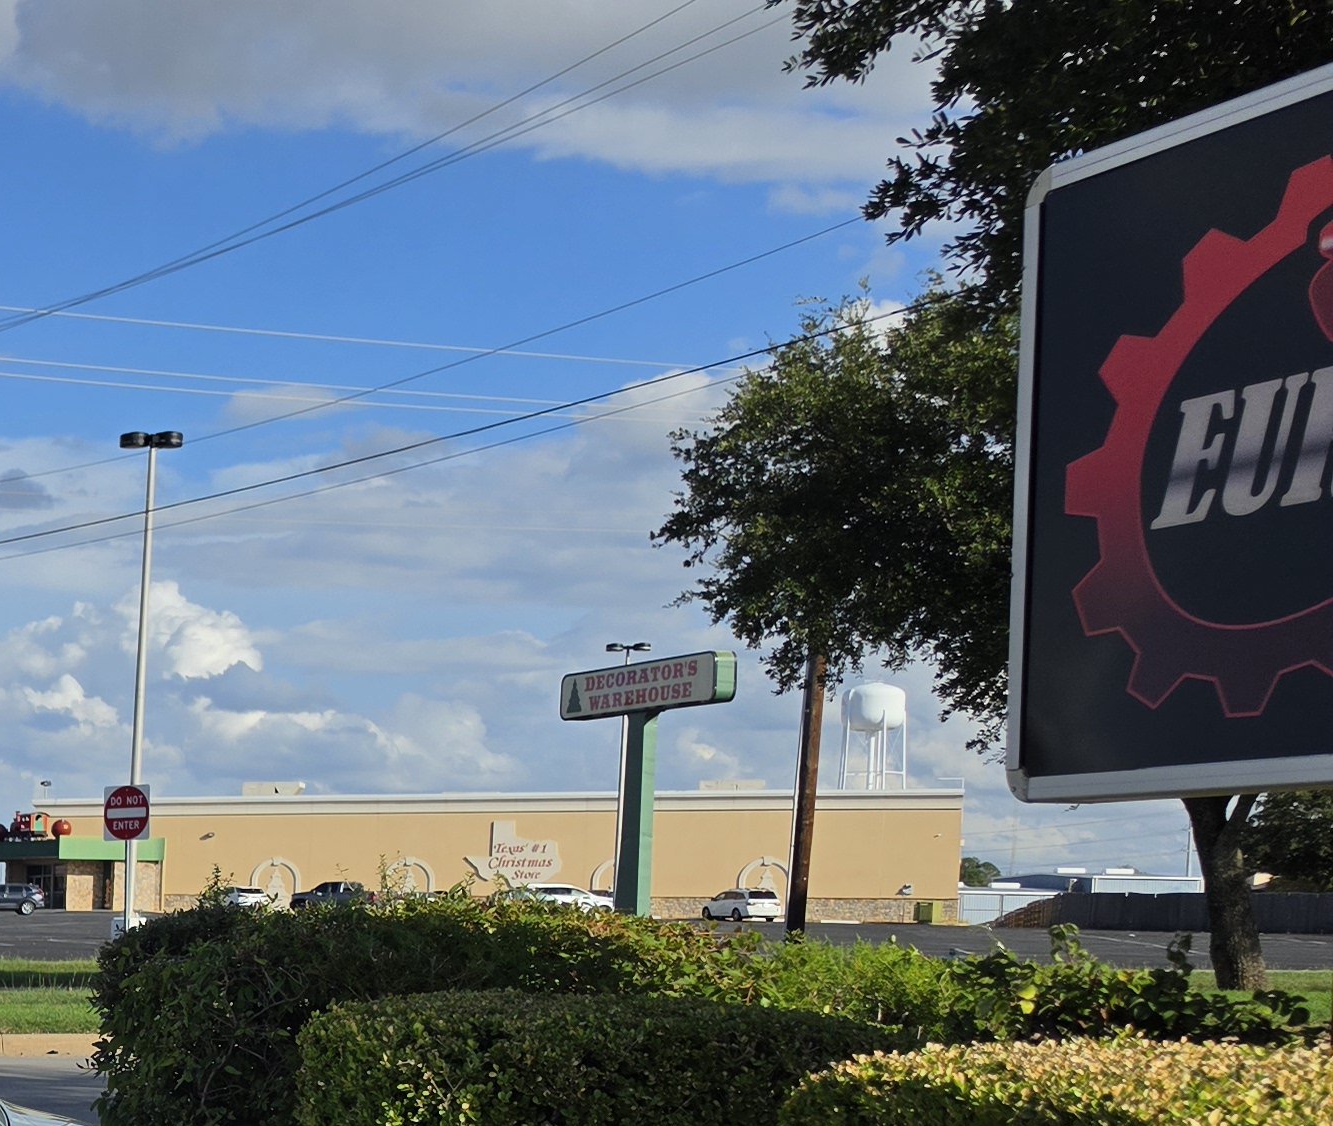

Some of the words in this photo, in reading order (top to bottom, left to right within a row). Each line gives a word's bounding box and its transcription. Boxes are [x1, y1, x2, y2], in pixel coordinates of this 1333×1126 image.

[584, 660, 698, 692] DECORATOR'S
[589, 682, 693, 711] WAREHOUSE
[110, 796, 123, 807] DO
[126, 795, 144, 806] NOT
[113, 820, 140, 831] ENTER
[531, 843, 547, 854] #1
[488, 855, 553, 869] Christmas
[512, 869, 542, 881] Store
